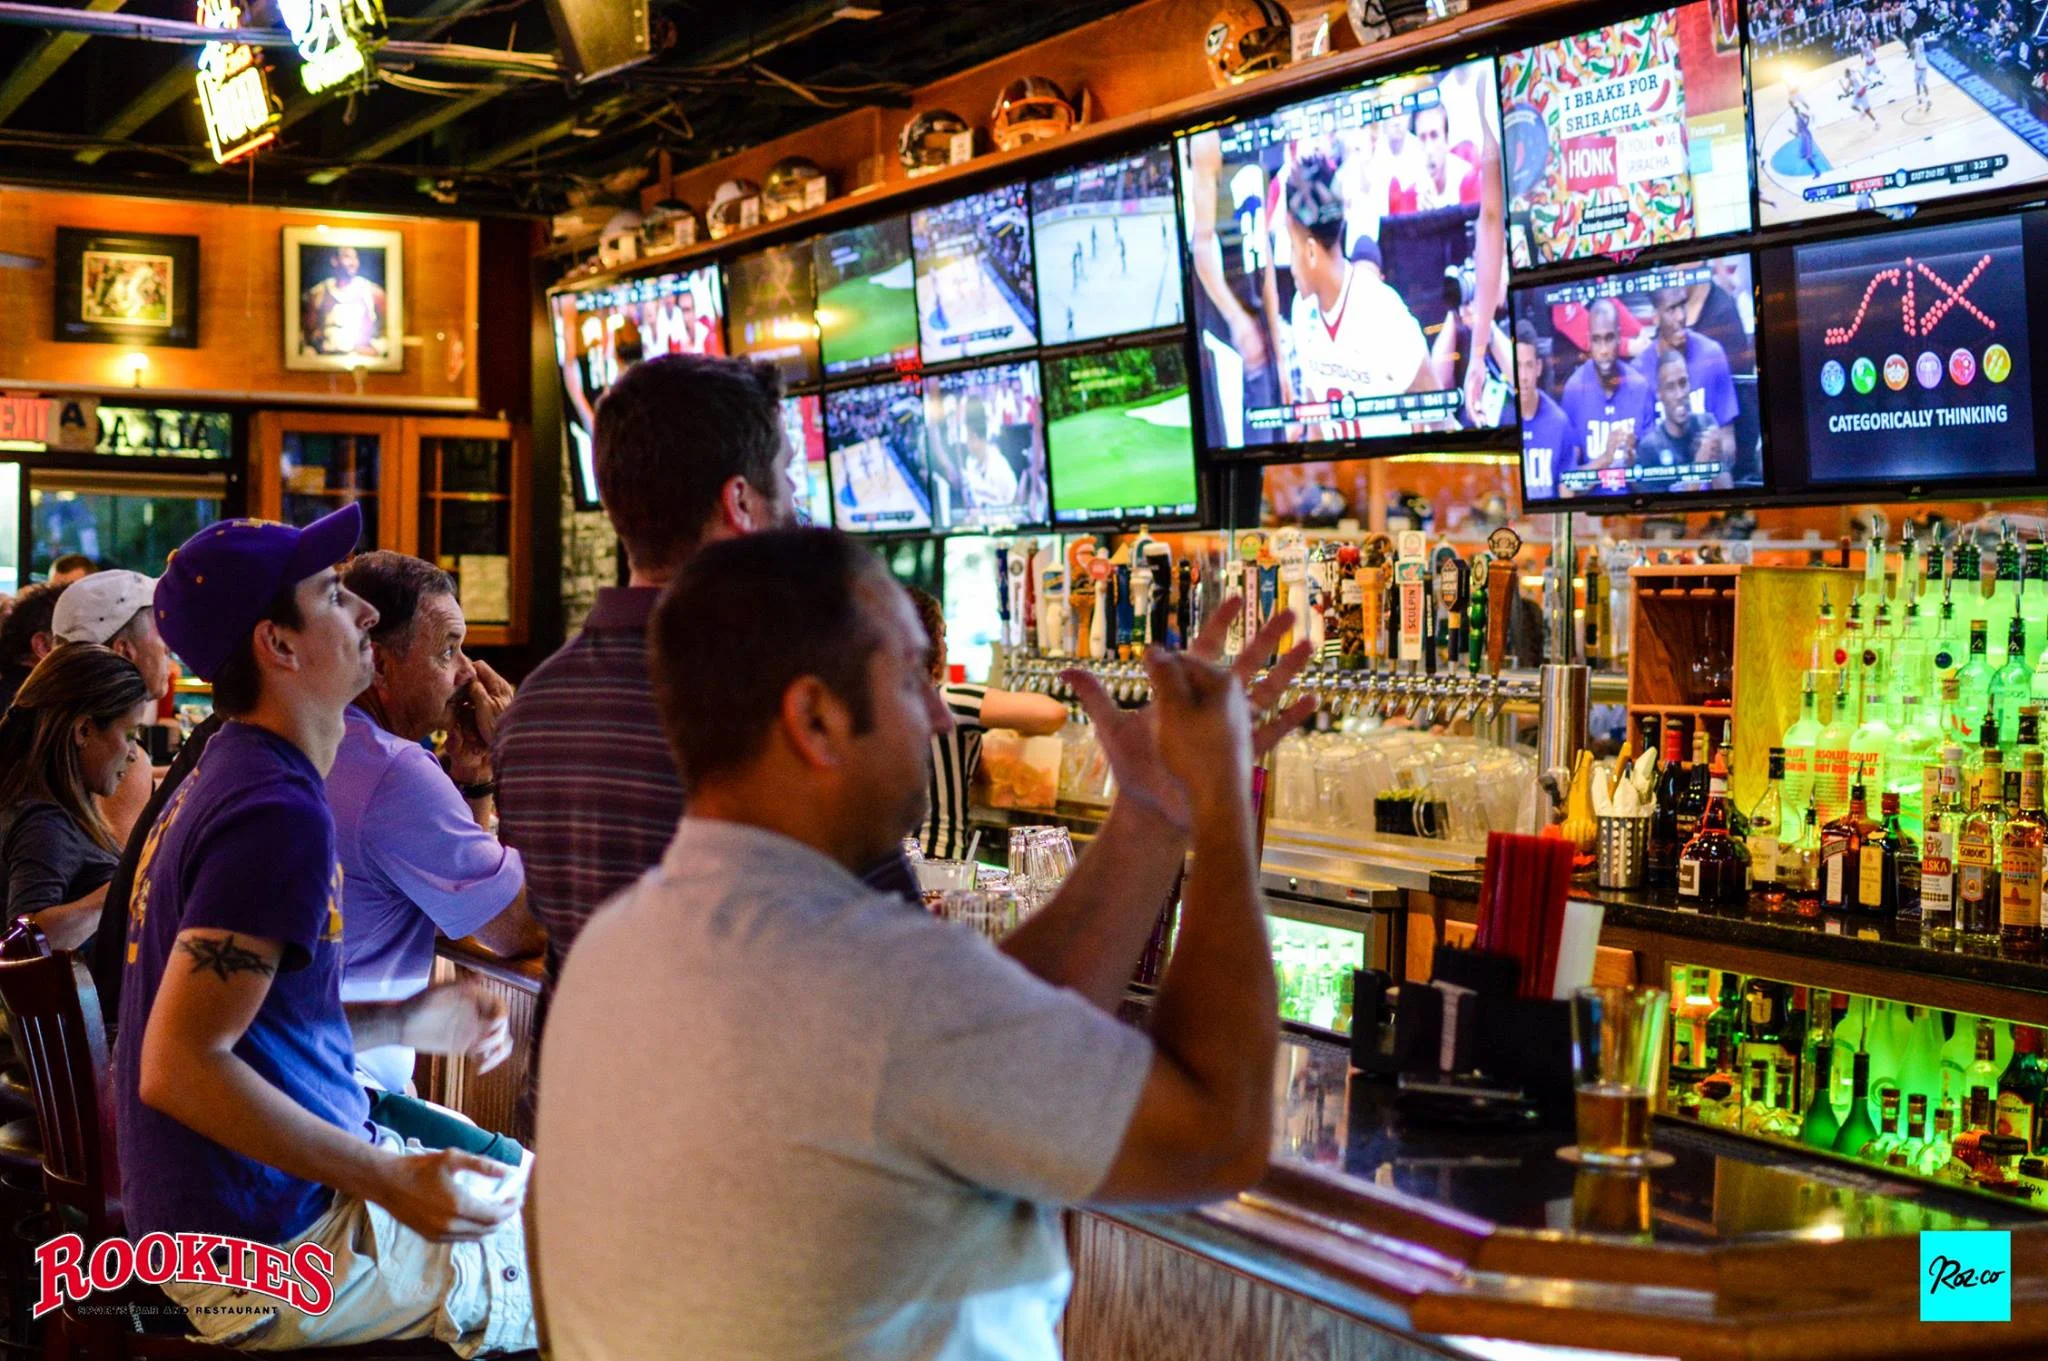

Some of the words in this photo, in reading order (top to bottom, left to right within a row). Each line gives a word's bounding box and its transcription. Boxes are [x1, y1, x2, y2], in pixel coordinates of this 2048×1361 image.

[1564, 96, 1571, 111] I
[1574, 83, 1626, 109] BRAKE
[1629, 74, 1659, 96] FOR
[1565, 102, 1643, 133] SRIRACHA
[1568, 147, 1616, 179] HONK
[0, 400, 48, 441] EXIT
[60, 402, 86, 428] A
[1828, 408, 1934, 433] CATEGORICALLY
[1936, 404, 2009, 427] THINKING
[1407, 588, 1417, 630] SCULPIN
